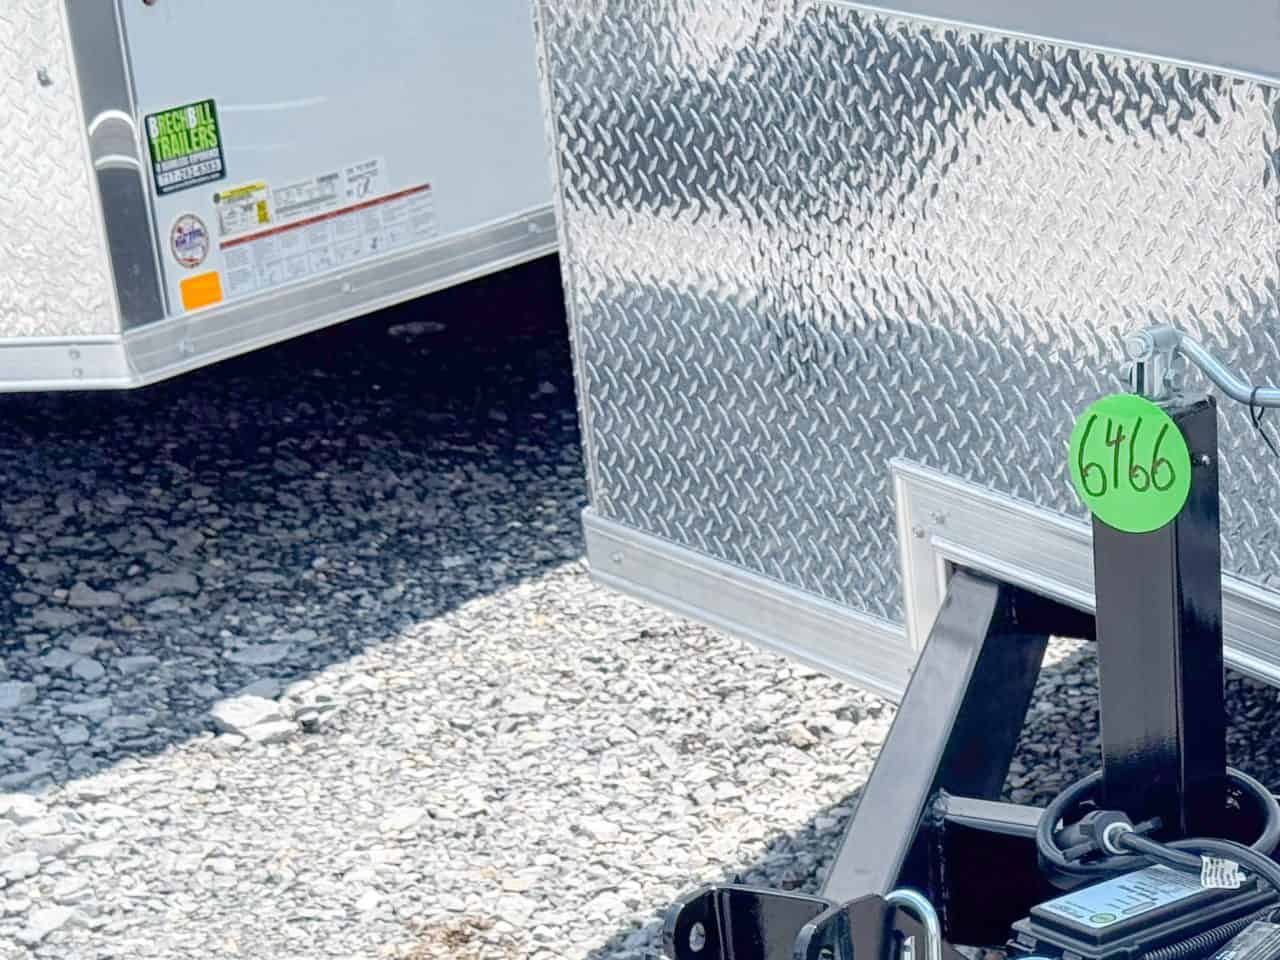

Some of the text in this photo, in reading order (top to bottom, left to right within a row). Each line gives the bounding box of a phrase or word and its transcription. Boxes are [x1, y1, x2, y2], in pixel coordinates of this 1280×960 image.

[147, 103, 214, 138] BRECHBILL
[151, 125, 218, 161] TRAILERS
[1078, 413, 1176, 497] 6466
